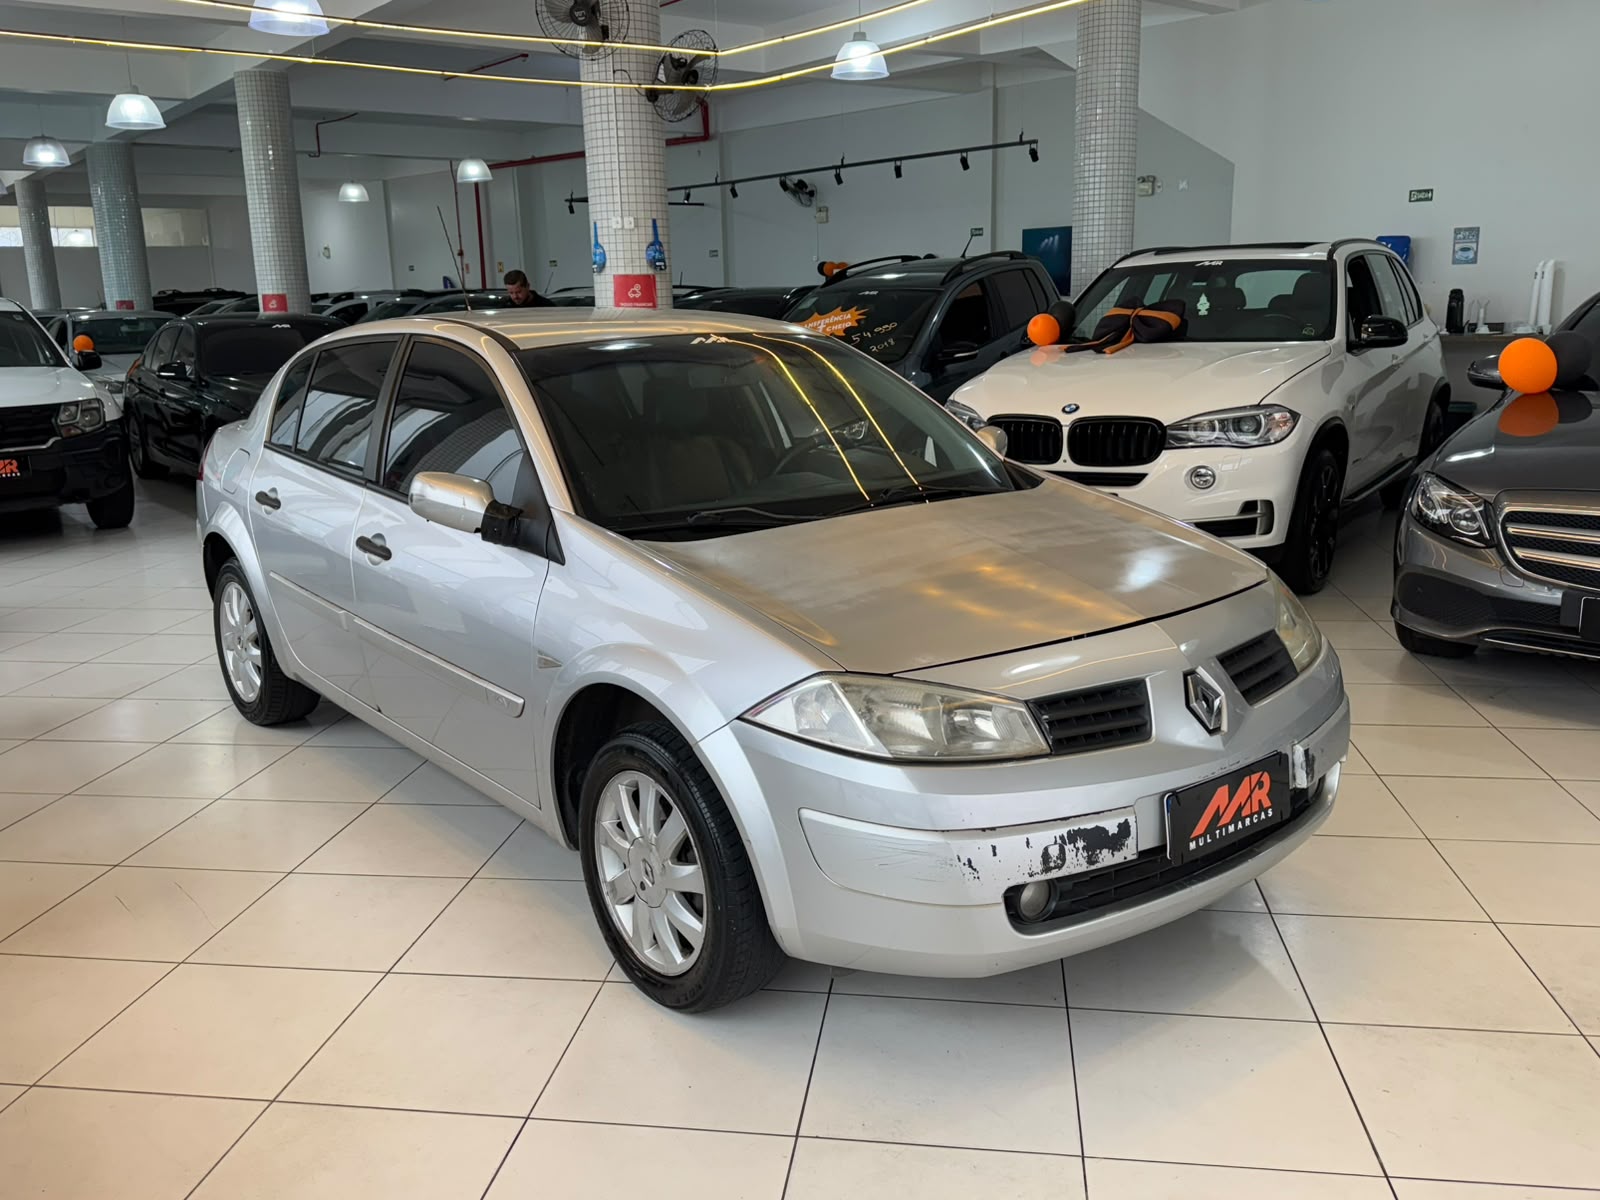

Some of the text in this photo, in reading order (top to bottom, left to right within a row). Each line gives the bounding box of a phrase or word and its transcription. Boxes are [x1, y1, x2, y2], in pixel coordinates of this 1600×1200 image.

[826, 322, 852, 332] CHEIO
[1190, 771, 1272, 839] MR
[1189, 808, 1273, 851] MULTIMARCAS
